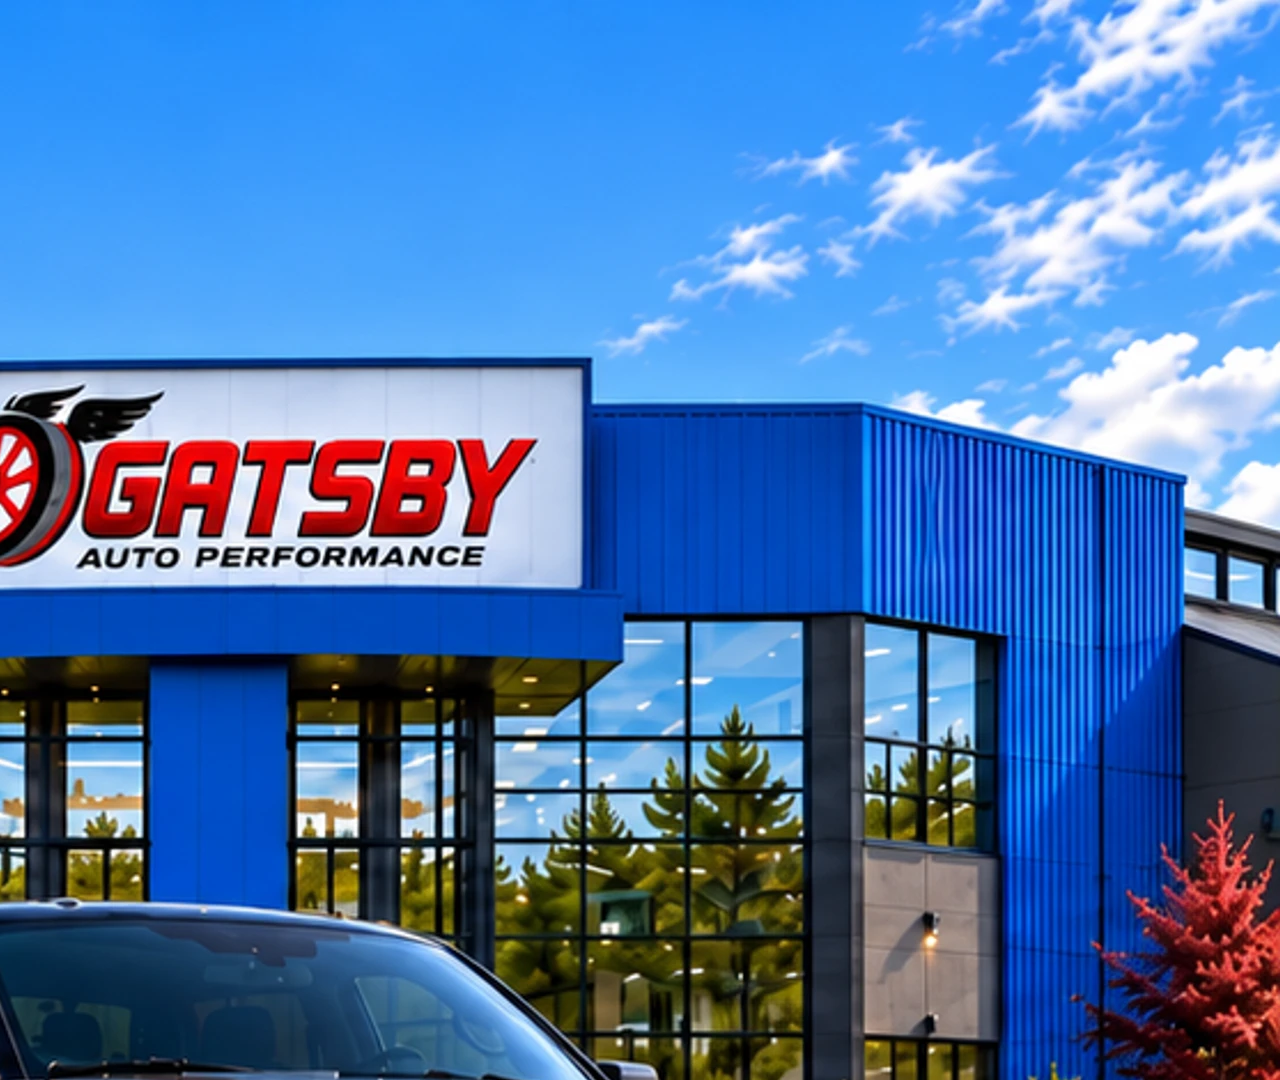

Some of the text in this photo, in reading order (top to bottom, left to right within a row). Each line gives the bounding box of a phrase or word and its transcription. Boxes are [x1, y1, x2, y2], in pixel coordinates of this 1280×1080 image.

[82, 438, 538, 539] GATSBY
[76, 546, 486, 569] AUTO PERFORMANCE
